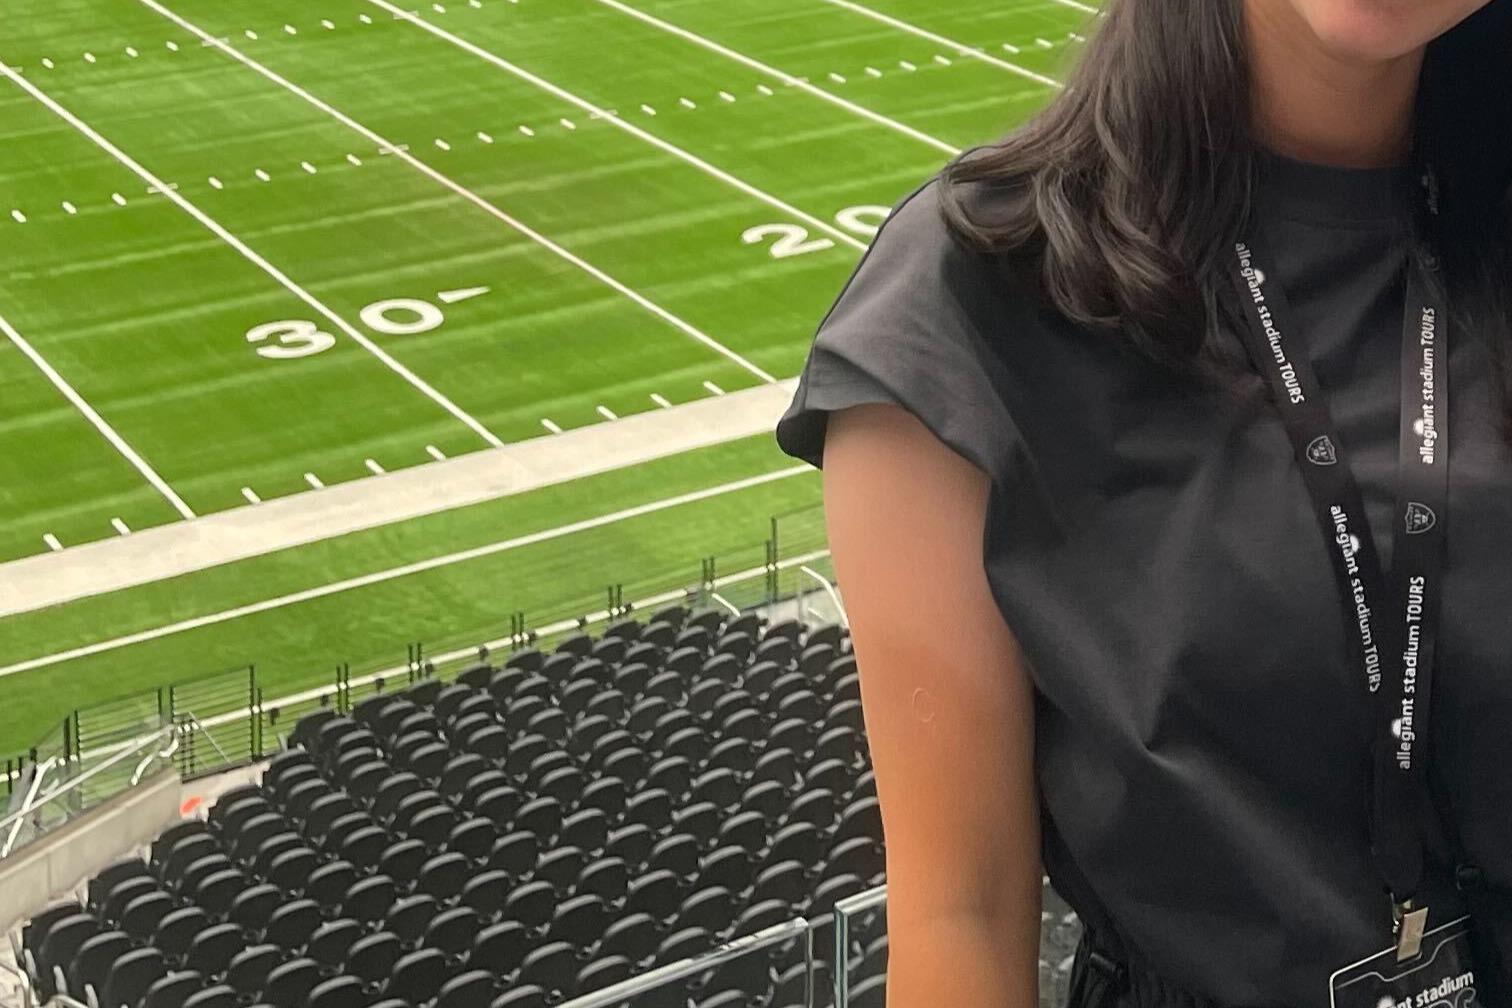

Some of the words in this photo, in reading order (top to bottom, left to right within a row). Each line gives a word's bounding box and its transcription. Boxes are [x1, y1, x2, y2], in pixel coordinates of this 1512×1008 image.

[245, 298, 445, 359] 30
[1234, 242, 1266, 304] allegiant
[1258, 304, 1286, 364] stadium
[1279, 362, 1305, 404] TOURS
[1420, 306, 1436, 345] TOURS
[1419, 347, 1435, 402] stadium
[1413, 404, 1438, 465] allegiant
[1330, 504, 1361, 575] allegiant
[1351, 577, 1372, 645] stadium
[1364, 644, 1382, 693] TOURS
[1406, 575, 1425, 623] TOURS
[1402, 624, 1420, 694] stadium
[1391, 697, 1416, 770] allegiant
[1415, 970, 1475, 1008] stadium
